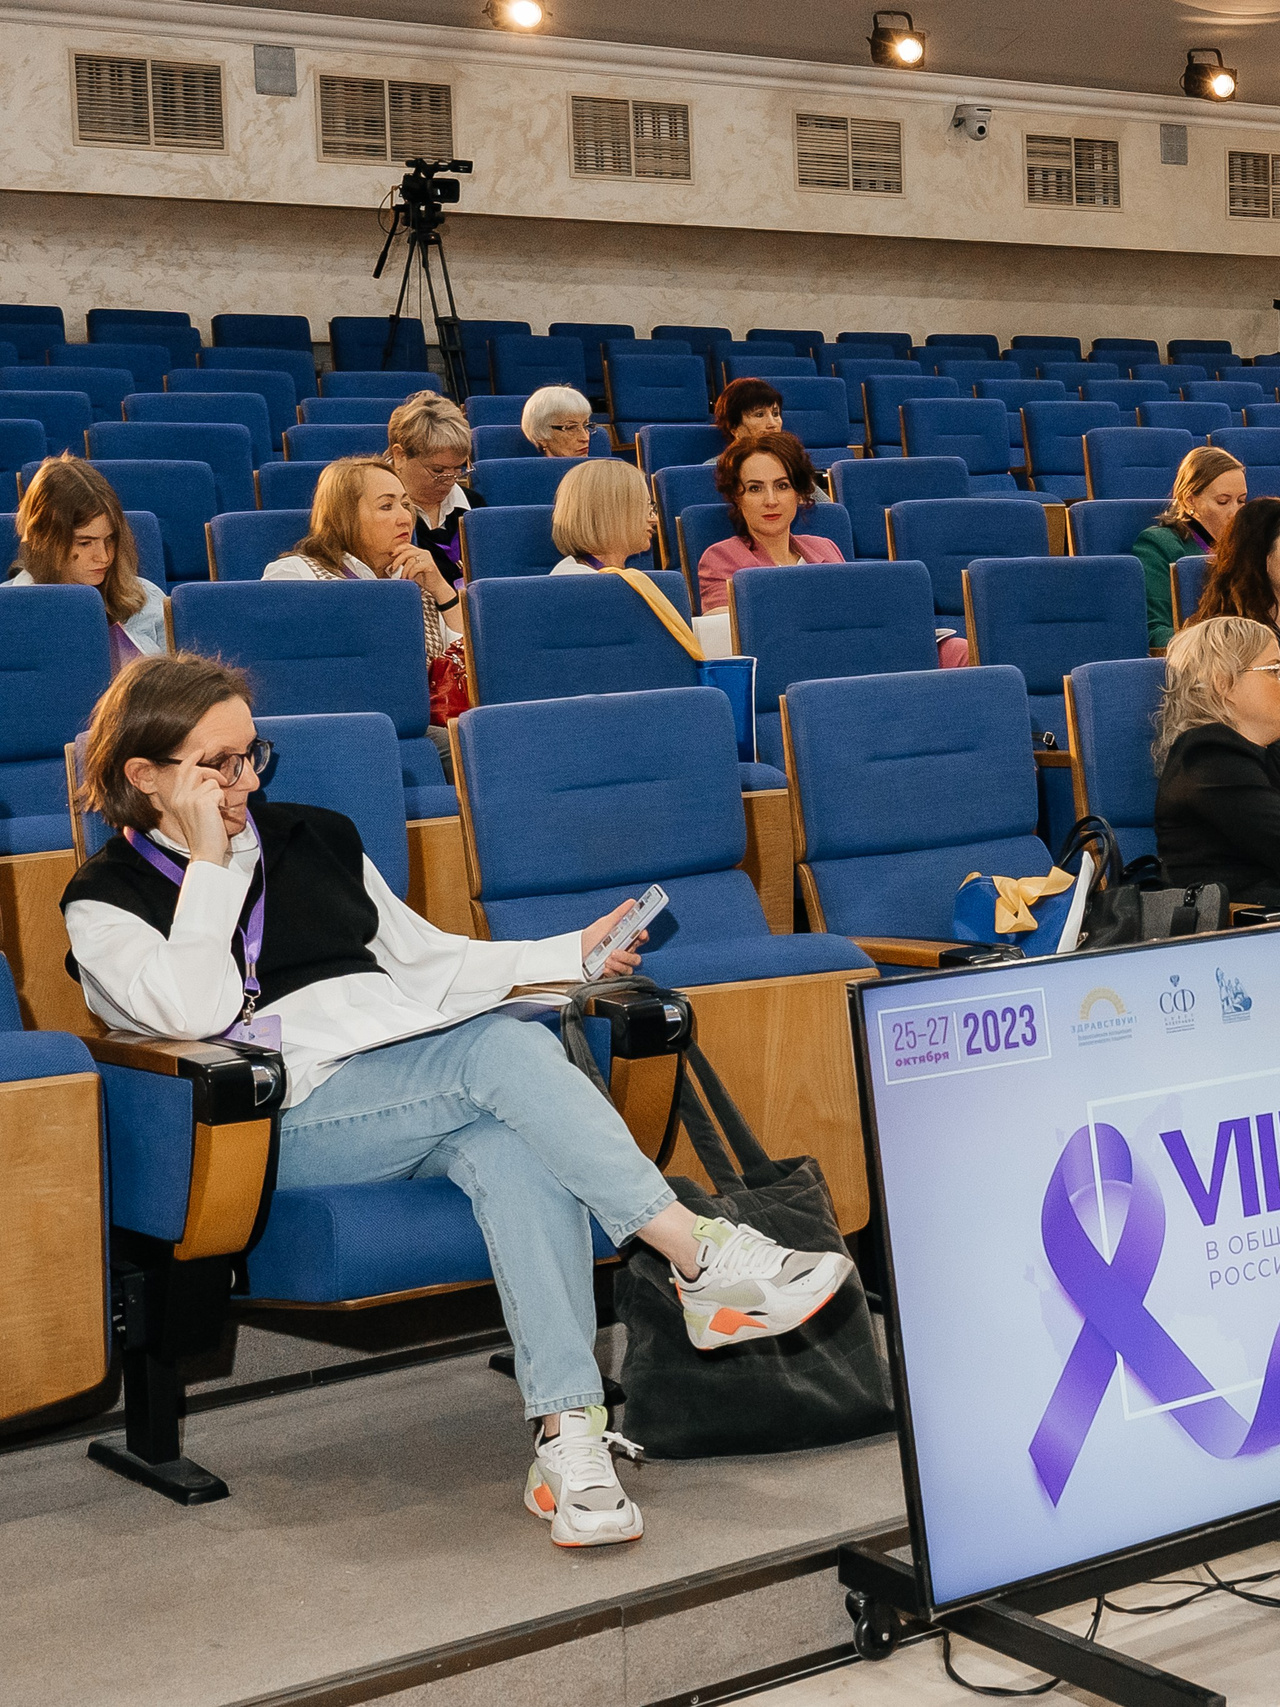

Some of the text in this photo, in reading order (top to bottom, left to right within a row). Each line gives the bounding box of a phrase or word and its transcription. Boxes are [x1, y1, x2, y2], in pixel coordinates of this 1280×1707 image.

[1160, 989, 1195, 1014] СФ
[892, 1016, 949, 1051] 25-27
[963, 1004, 1037, 1056] 2023
[895, 1050, 950, 1067] октября
[1205, 1240, 1220, 1262] В
